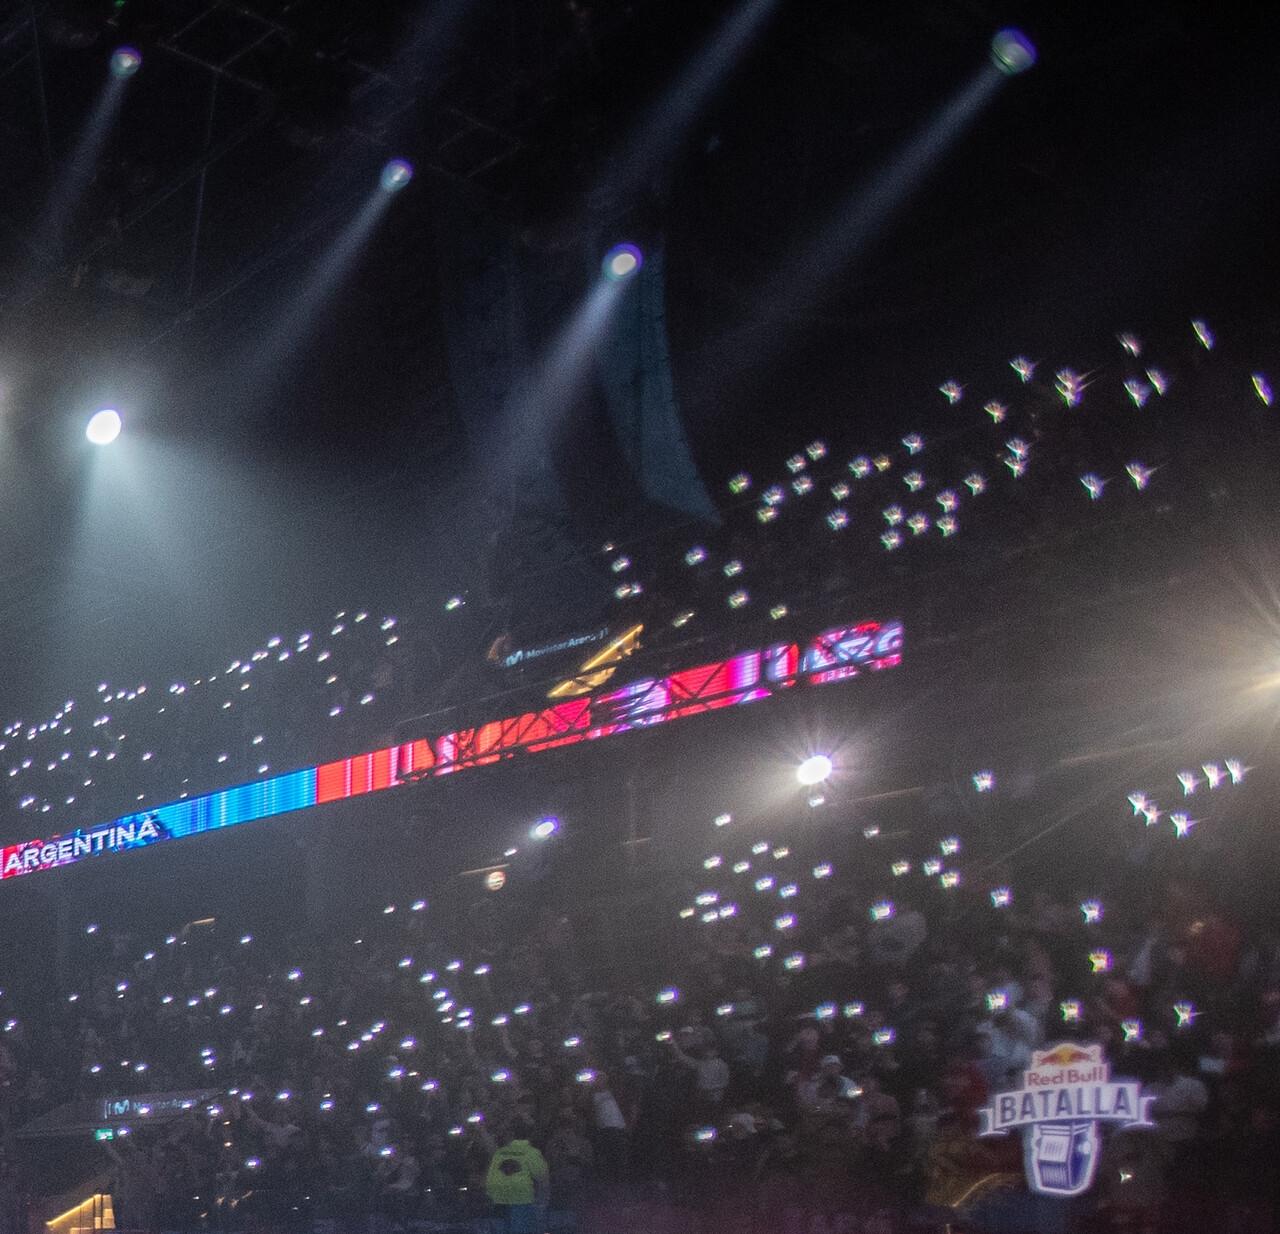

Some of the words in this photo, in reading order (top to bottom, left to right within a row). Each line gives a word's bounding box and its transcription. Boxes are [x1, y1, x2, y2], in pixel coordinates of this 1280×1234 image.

[3, 815, 159, 872] ARGENTINA
[1027, 1070, 1064, 1087] Red
[1067, 1067, 1103, 1083] Bull
[1000, 1086, 1132, 1124] BATALLA
